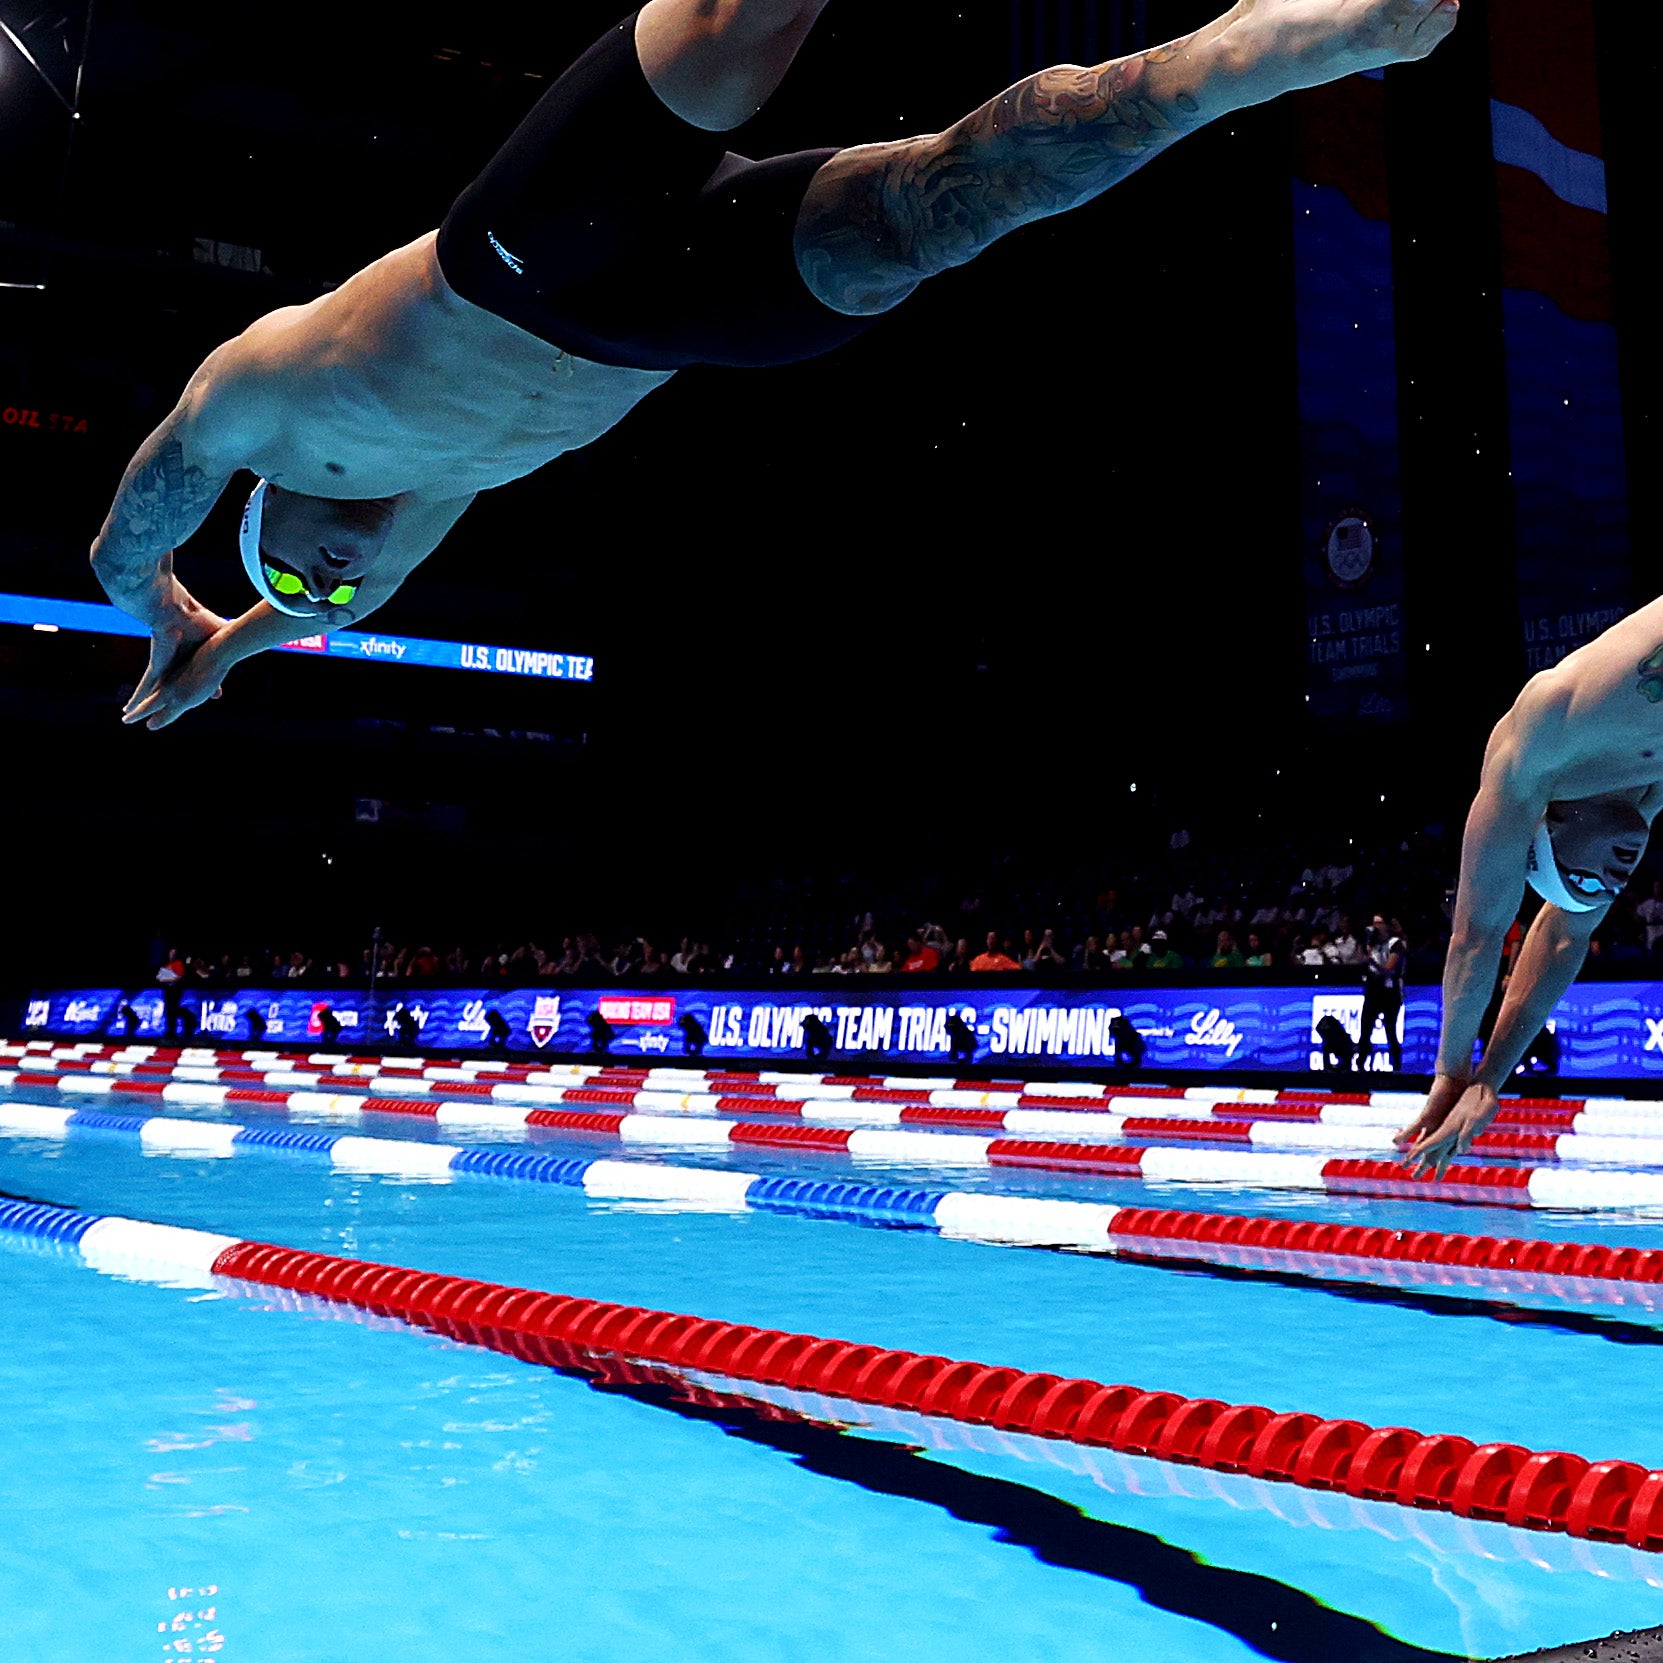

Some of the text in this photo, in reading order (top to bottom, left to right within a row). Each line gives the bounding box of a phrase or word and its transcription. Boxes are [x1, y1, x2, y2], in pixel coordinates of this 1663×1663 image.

[1338, 604, 1399, 634] OLYMPIC
[359, 637, 408, 659] xfinity
[461, 644, 493, 670] U.S.
[496, 648, 564, 678] OLYMPIC
[709, 1006, 744, 1047] U.S.
[835, 1007, 894, 1051] TEAM
[1185, 1008, 1244, 1058] Lilly
